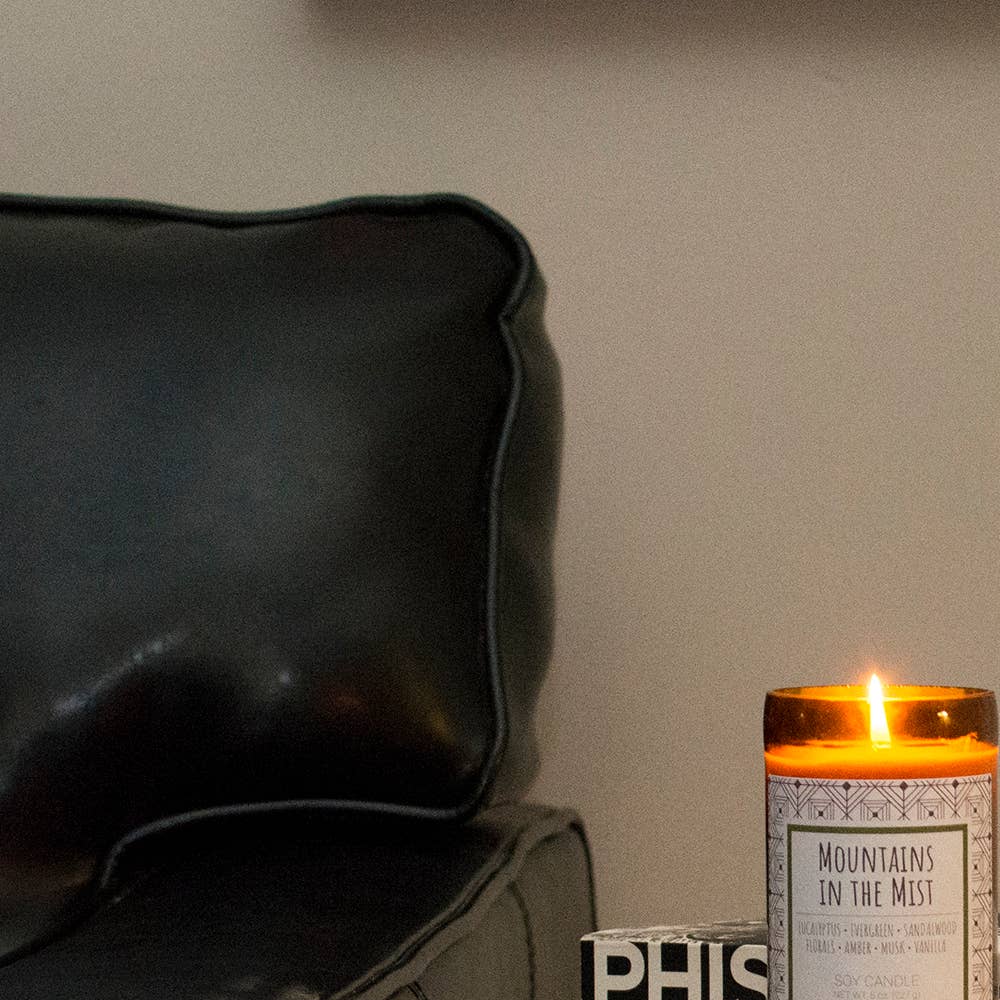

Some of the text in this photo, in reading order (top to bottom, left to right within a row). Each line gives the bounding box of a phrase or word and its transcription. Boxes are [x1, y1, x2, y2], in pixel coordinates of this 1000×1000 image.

[818, 841, 934, 873] MOUNTAINS
[819, 876, 934, 907] IN THE MIST
[851, 923, 894, 938] EVERGREEN
[903, 921, 958, 937] SANDALWOOD
[844, 941, 872, 955] AMBER
[881, 941, 905, 955] MUSK
[834, 974, 920, 988] SOY CANDLE
